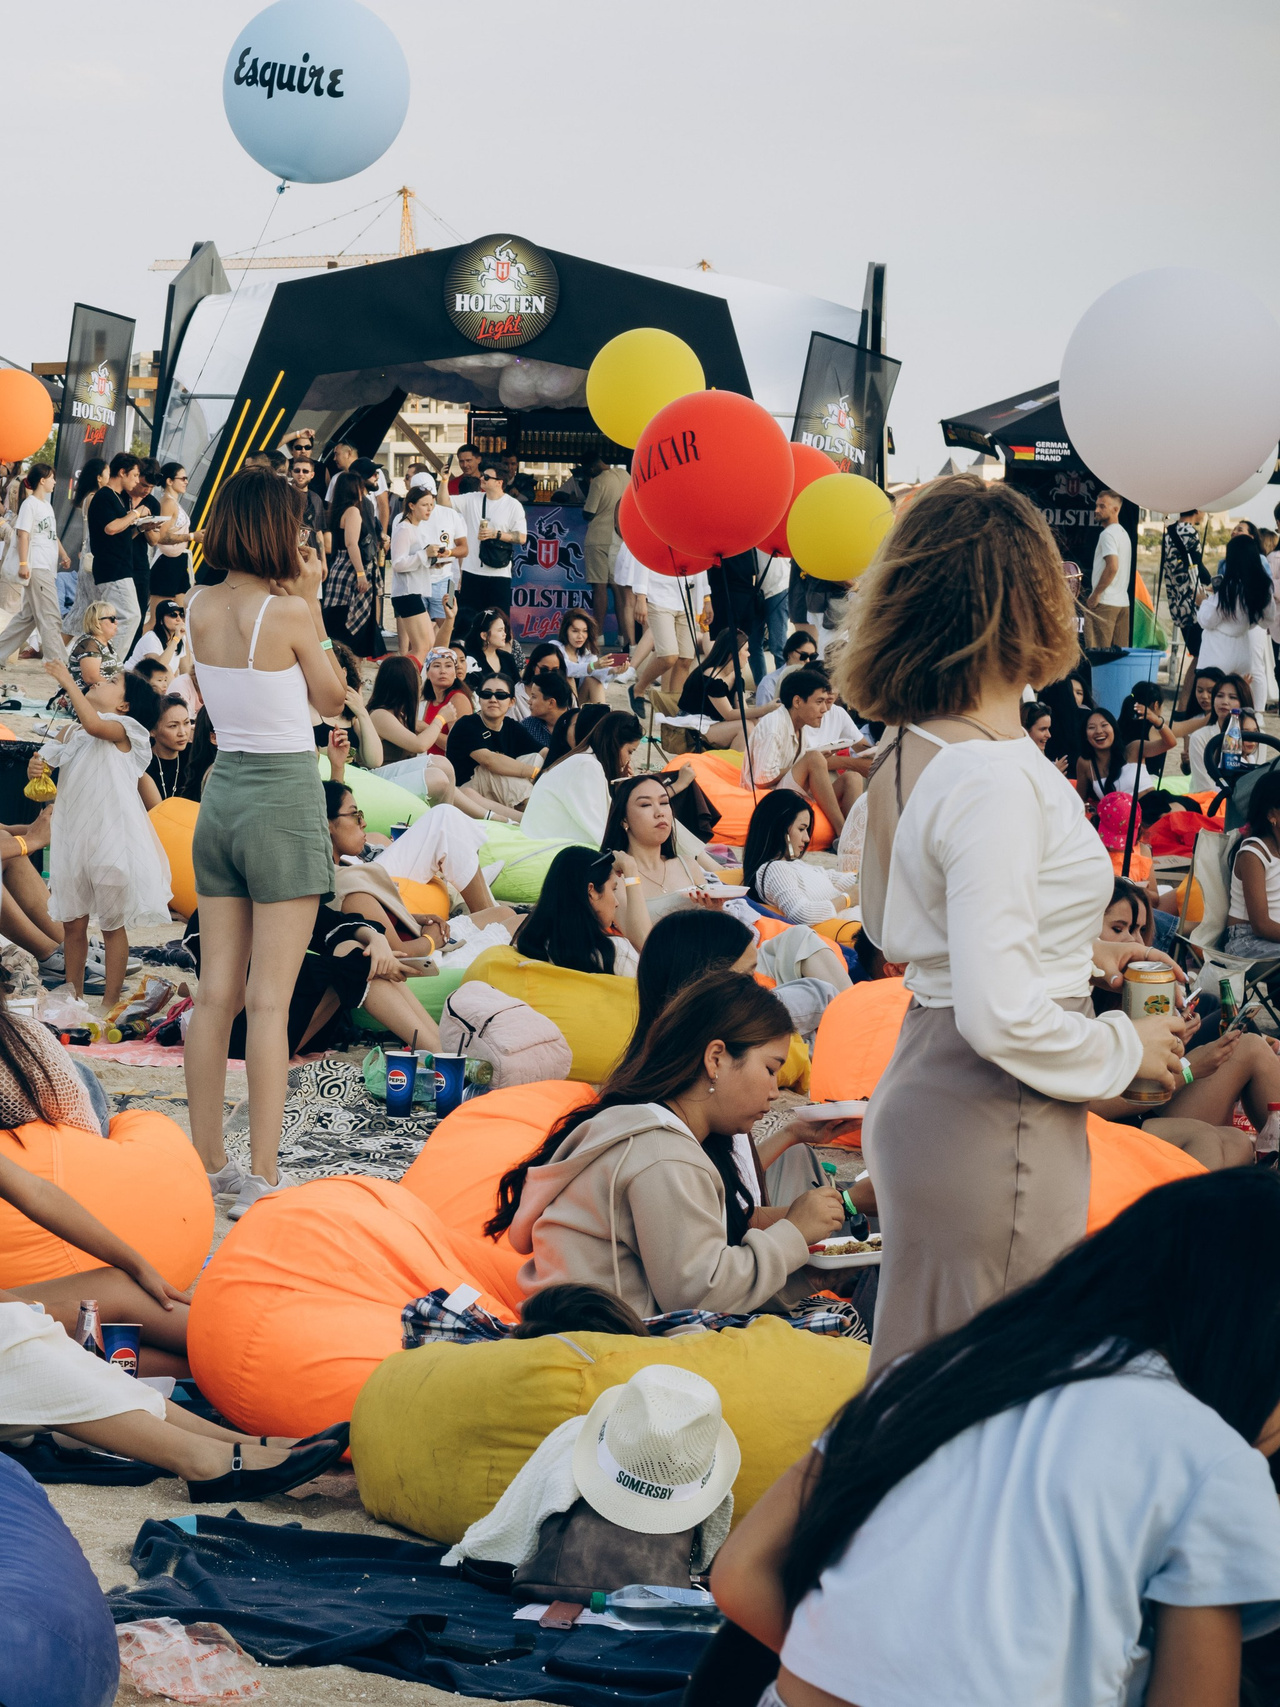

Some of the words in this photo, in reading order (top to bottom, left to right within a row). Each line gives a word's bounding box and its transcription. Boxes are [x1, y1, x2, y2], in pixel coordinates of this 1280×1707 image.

[234, 47, 344, 99] Esquire
[455, 293, 546, 314] HOLSTEN
[477, 315, 522, 340] Light
[72, 401, 116, 426] HOLSTEN
[83, 424, 108, 446] Light
[1035, 441, 1068, 449] GERMAN
[801, 431, 866, 465] HOLSTEN
[1035, 448, 1070, 456] PREMIUM
[1041, 507, 1104, 527] OLSTE
[521, 612, 563, 639] Ligh
[616, 1470, 674, 1500] SOMERSBY
